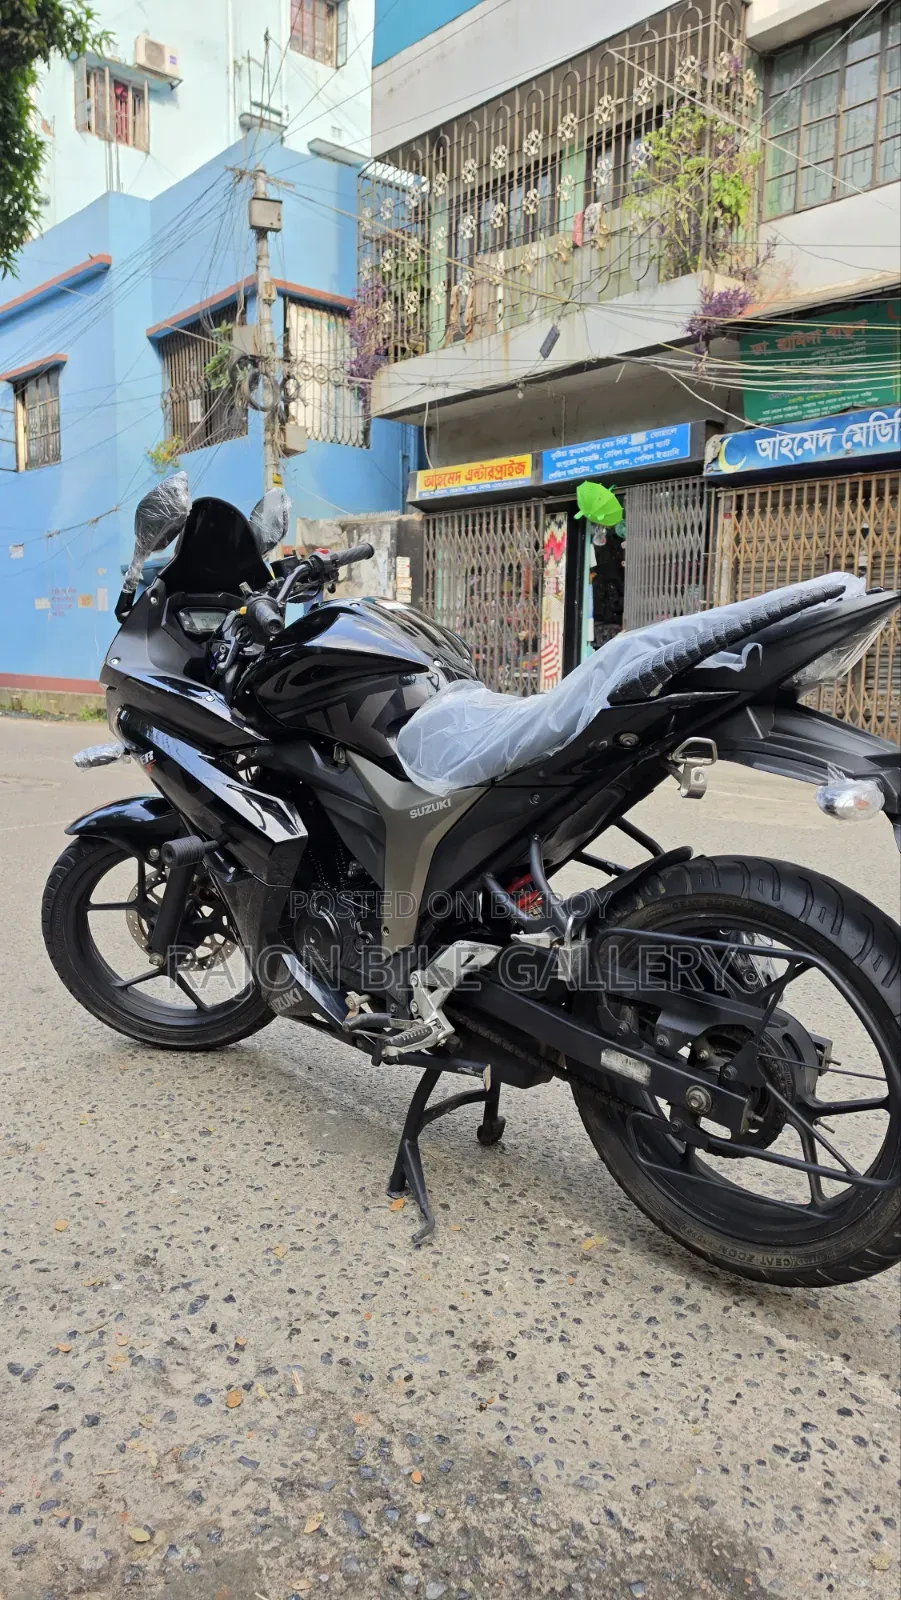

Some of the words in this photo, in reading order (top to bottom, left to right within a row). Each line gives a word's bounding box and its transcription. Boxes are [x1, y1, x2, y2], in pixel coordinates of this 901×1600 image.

[755, 428, 836, 461] আহমেদ
[842, 408, 901, 449] মেডি
[424, 471, 462, 487] আহমেদ
[409, 799, 451, 819] SUZUKI
